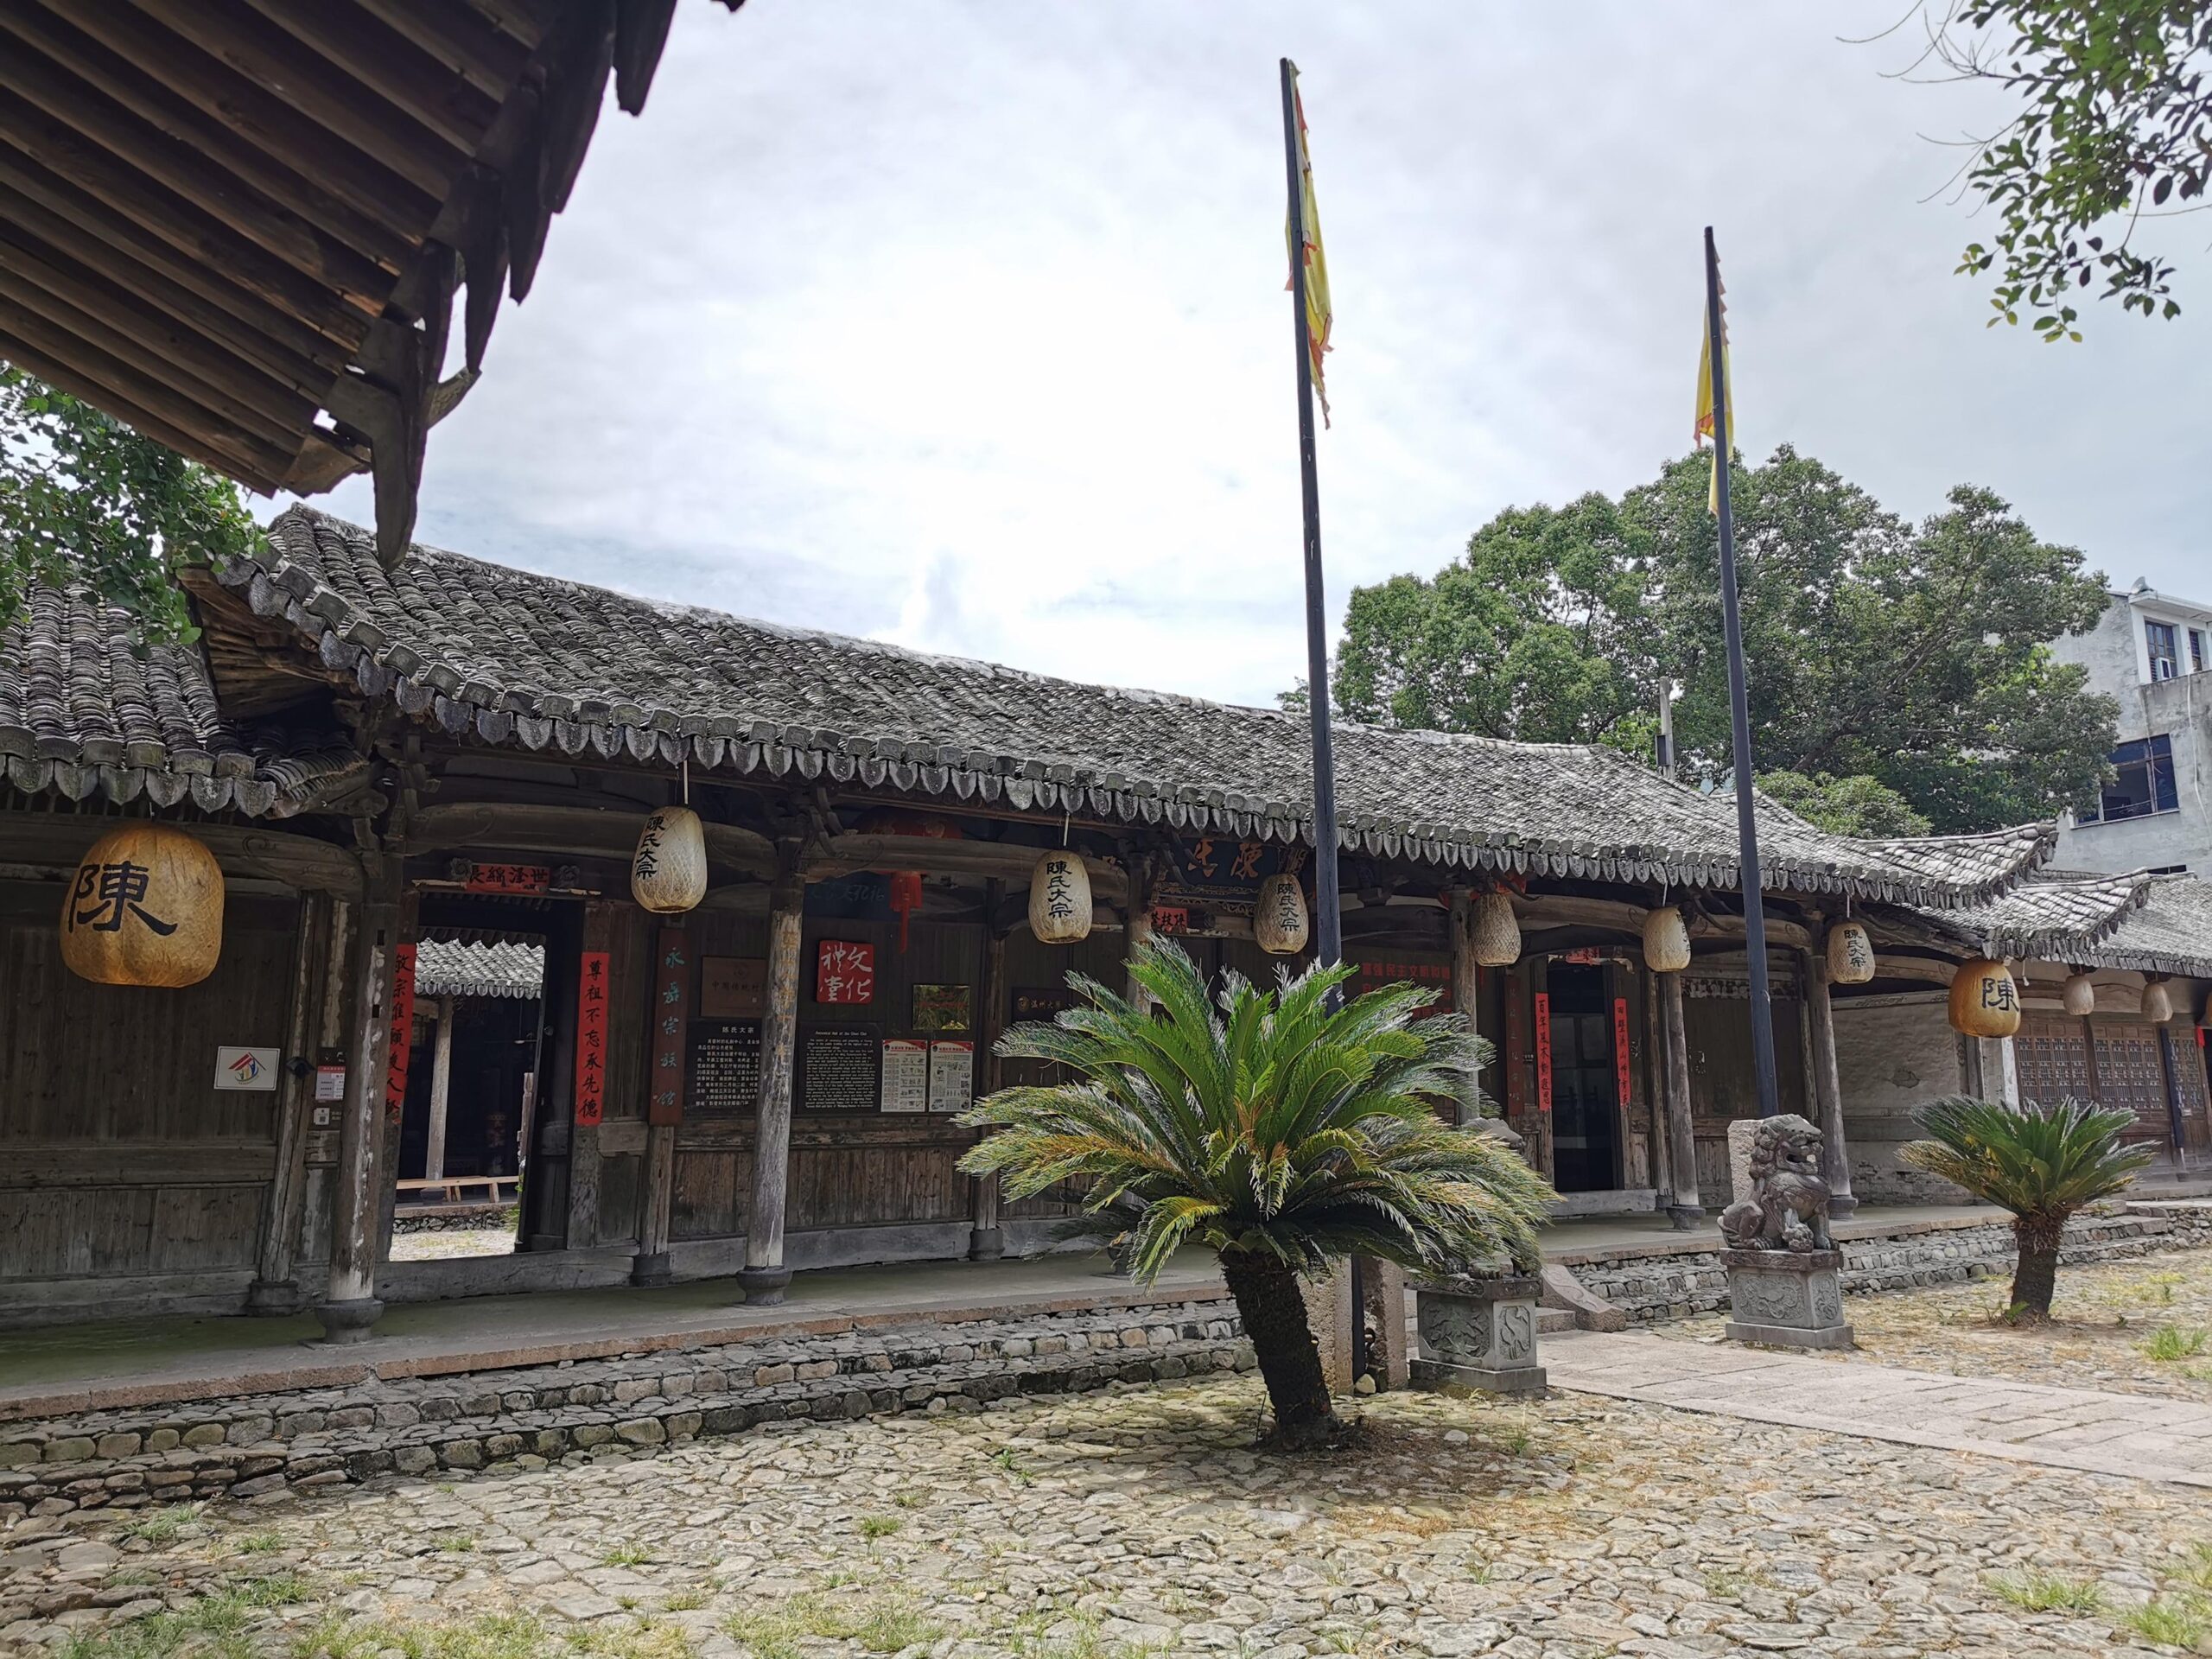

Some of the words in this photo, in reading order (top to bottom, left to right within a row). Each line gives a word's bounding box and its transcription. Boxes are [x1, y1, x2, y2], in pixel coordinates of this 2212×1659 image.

[635, 815, 666, 880] 陳氏大宗
[69, 861, 178, 937] 陳
[1046, 861, 1073, 919] 陳氏大宗
[1277, 883, 1305, 932] 陳氏大宗
[1842, 929, 1867, 968] 陳氏大宗
[1981, 977, 2019, 1013] 陳
[578, 960, 604, 1118] 尊祖不忘承先德
